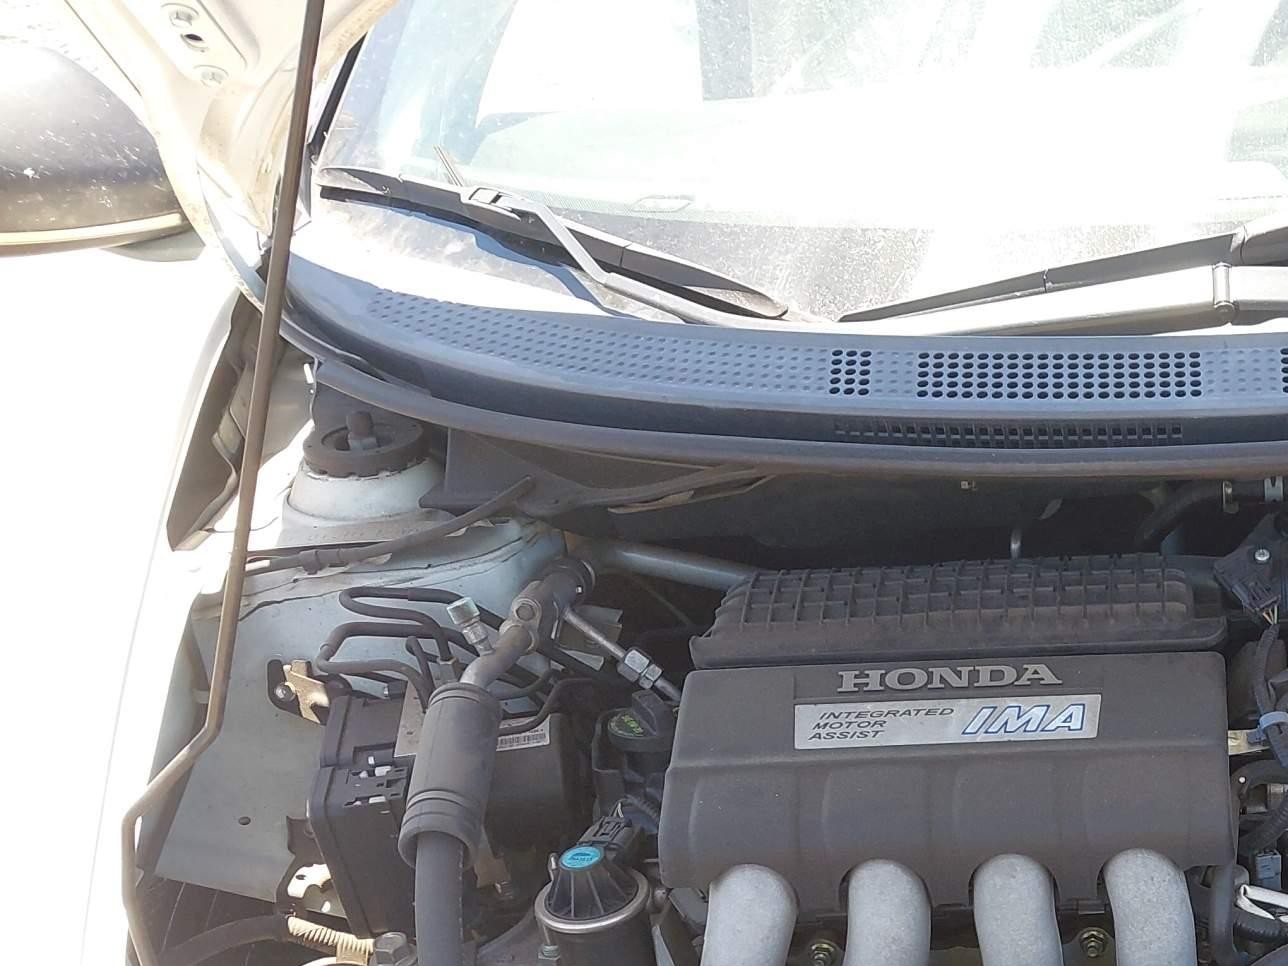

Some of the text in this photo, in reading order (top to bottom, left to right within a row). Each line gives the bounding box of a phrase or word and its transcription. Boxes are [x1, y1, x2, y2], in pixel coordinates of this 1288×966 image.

[837, 664, 1062, 693] HONDA
[819, 708, 954, 721] INTEGRATED
[962, 704, 1086, 735] IMA
[812, 721, 887, 731] MOTOR
[808, 731, 885, 741] ASSIST
